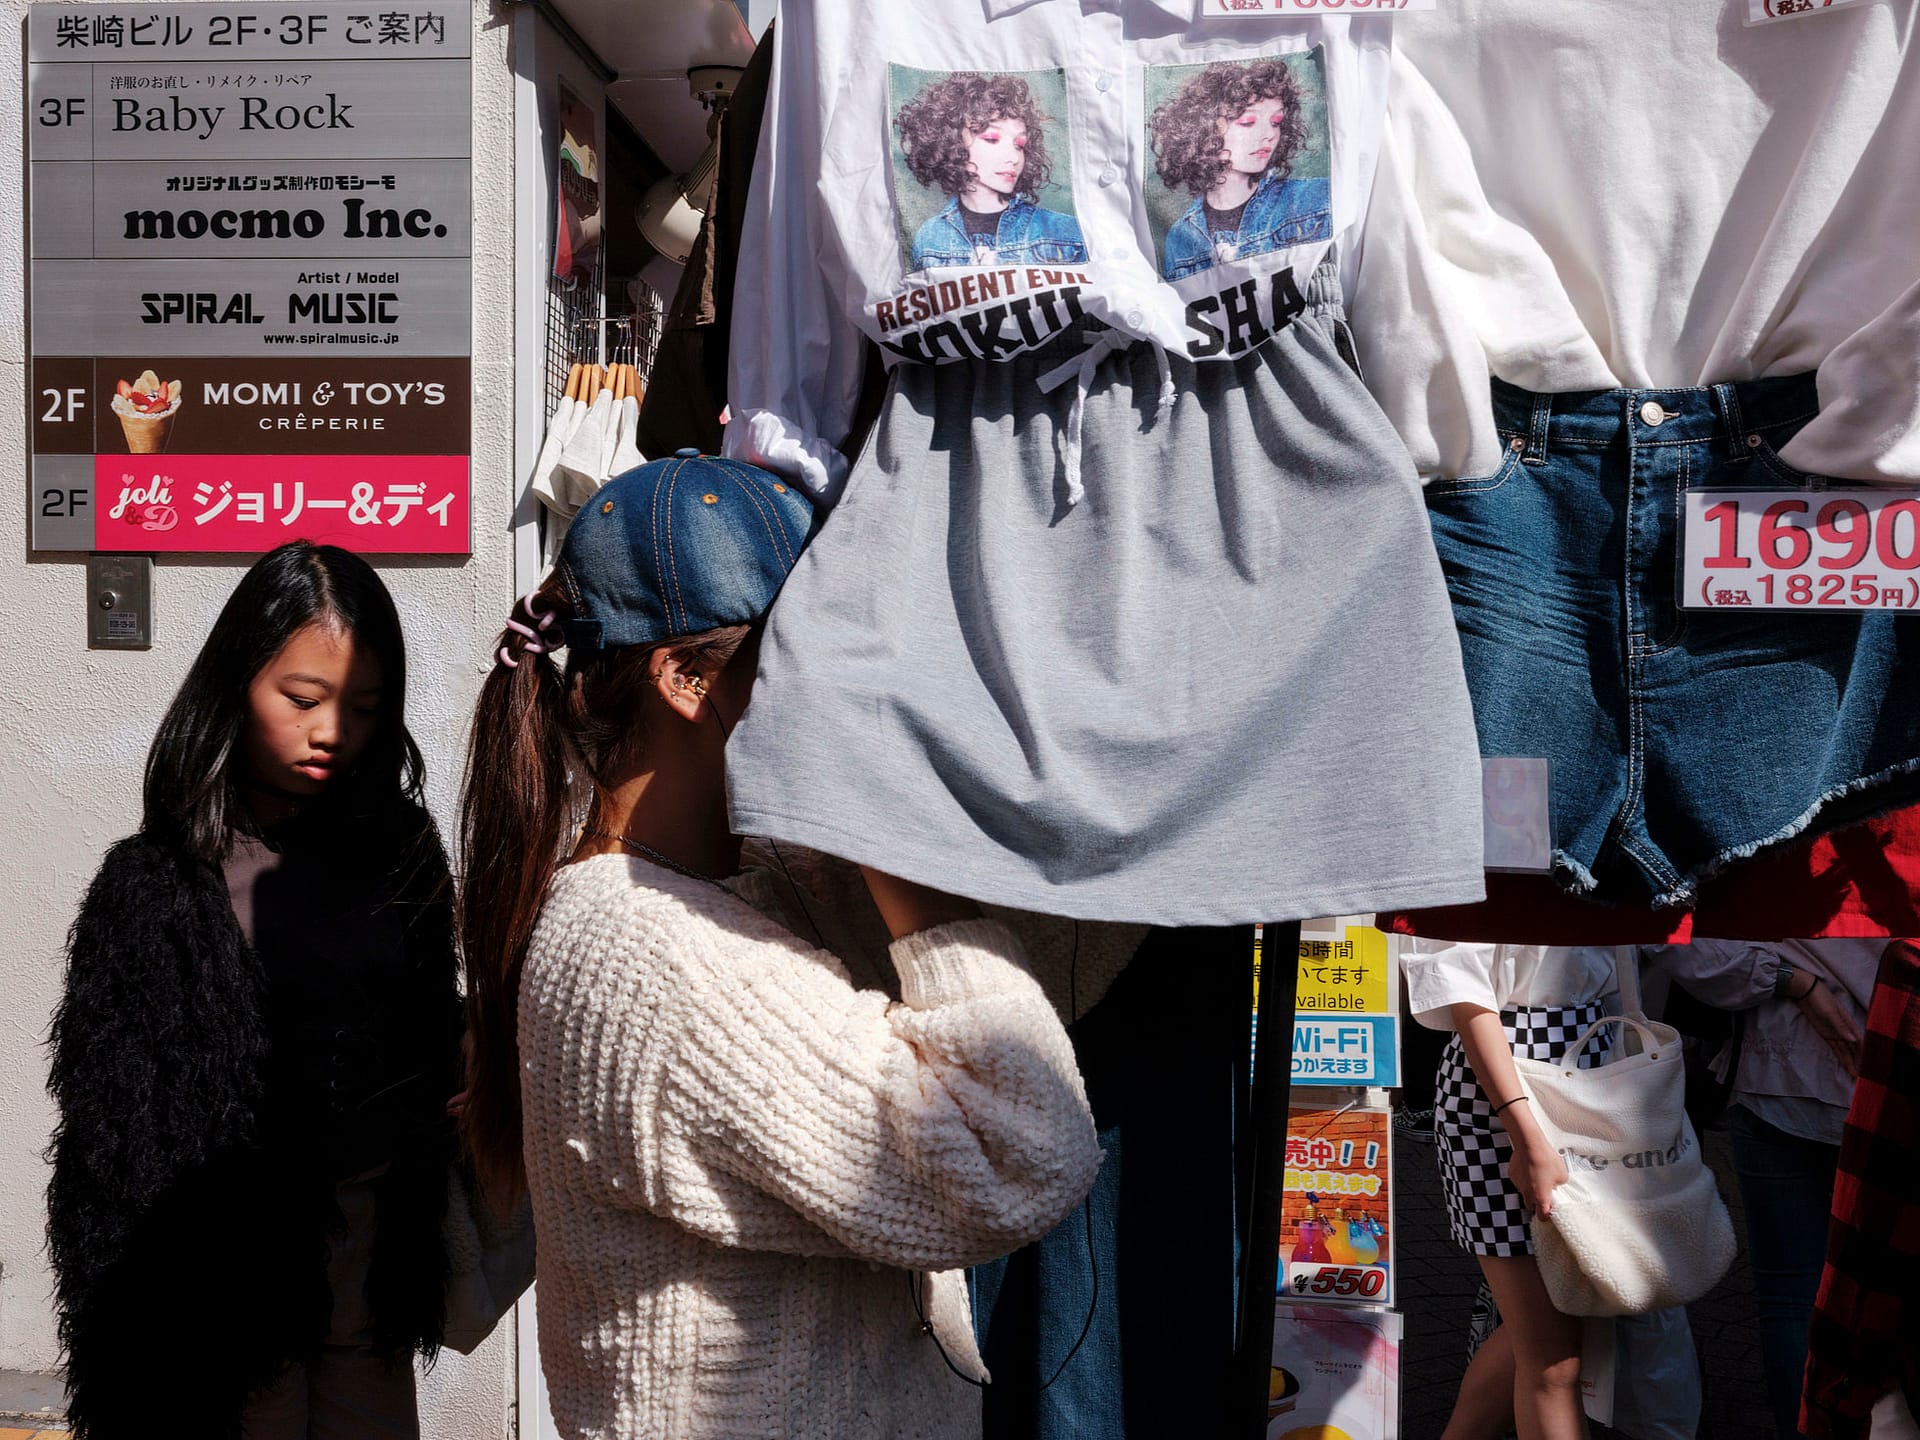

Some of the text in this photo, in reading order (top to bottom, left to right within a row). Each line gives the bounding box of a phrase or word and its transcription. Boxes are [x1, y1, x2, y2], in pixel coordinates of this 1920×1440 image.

[57, 15, 193, 48] 柴崎ビル
[346, 12, 445, 44] ご案内
[110, 74, 313, 90] 洋服のお直し・リメイク・リペア
[40, 98, 85, 126] 3F
[112, 94, 355, 140] Baby Rock
[166, 175, 396, 191] オリジナルグッズ制作のモシーモ
[123, 198, 447, 239] mocmo Inc.
[297, 272, 341, 284] Artist
[357, 272, 400, 284] Model
[140, 293, 399, 324] SPIRAL MUSIC
[876, 269, 1017, 333] RESIDENT
[1184, 267, 1306, 358] SHA
[263, 332, 400, 346] www.spiralmusic.jp
[41, 388, 86, 423] 2F
[203, 382, 446, 408] MOMI & TOY'S
[259, 414, 386, 431] CRÊPERIE
[41, 489, 88, 518] 2F
[109, 474, 174, 519] joli
[192, 480, 456, 527] ジョリー&ディ
[1703, 499, 1920, 571] 1690
[1297, 993, 1365, 1009] vailable
